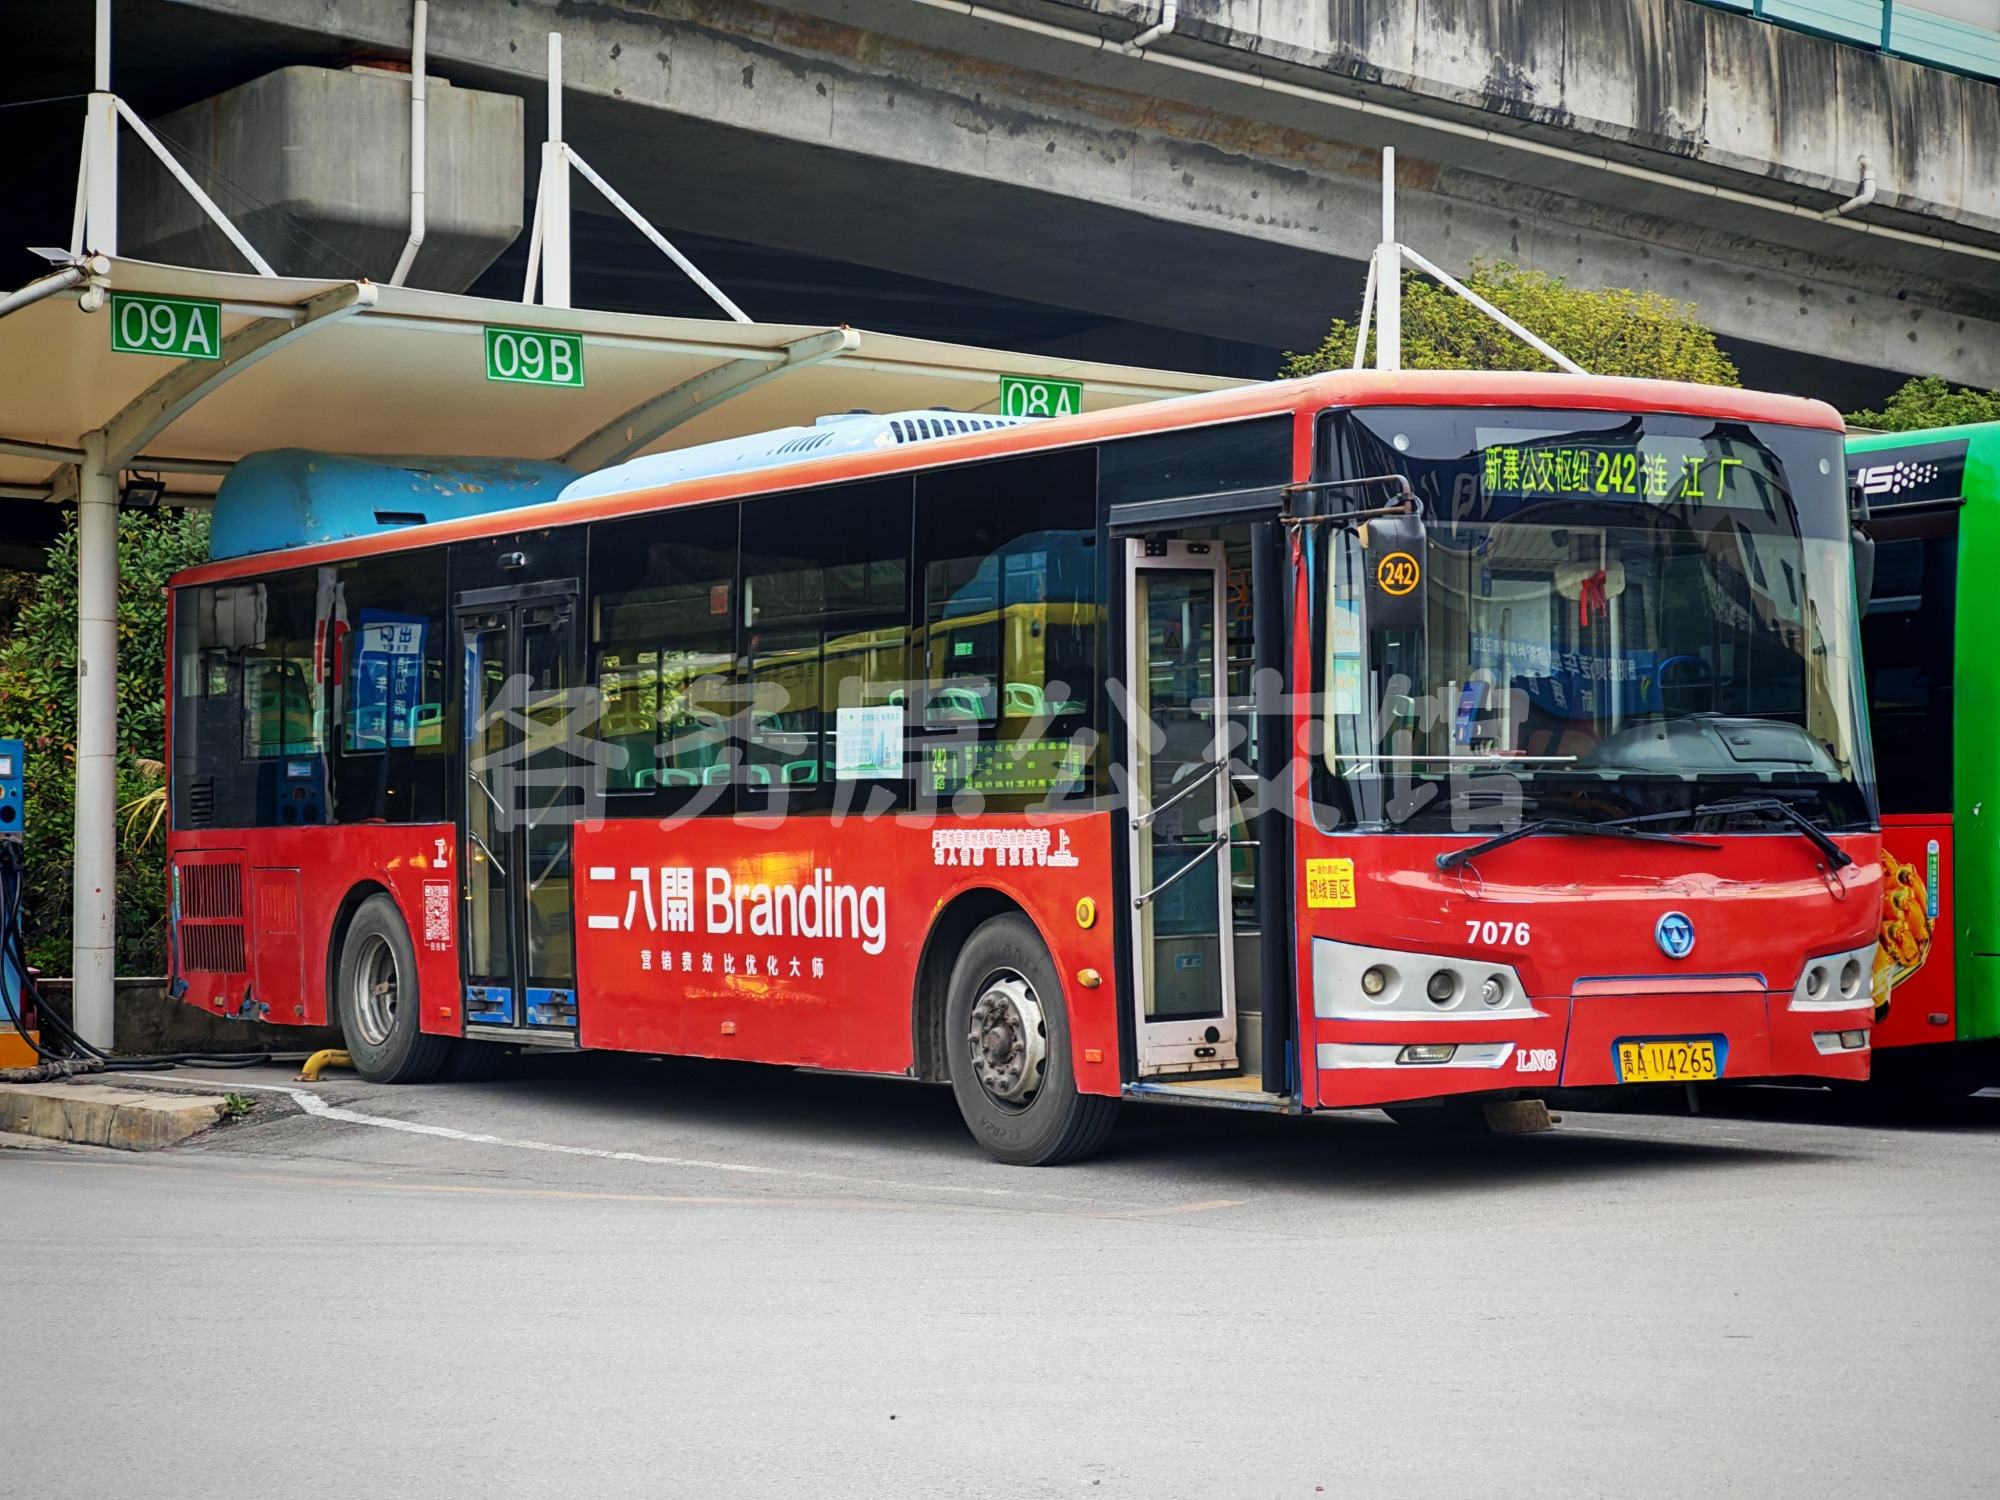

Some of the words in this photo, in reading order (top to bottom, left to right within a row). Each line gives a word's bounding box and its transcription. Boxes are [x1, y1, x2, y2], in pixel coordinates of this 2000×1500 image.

[121, 302, 212, 354] 09A
[494, 334, 574, 382] 09B
[1007, 382, 1072, 417] 08A
[1485, 447, 1590, 492] 新寨公交枢纽
[1596, 453, 1636, 494] 242
[1385, 562, 1413, 585] 242
[1054, 828, 1070, 857] 上
[1310, 879, 1351, 899] 视线盲区
[588, 866, 695, 933] 二八開
[706, 867, 886, 955] Branding
[1466, 920, 1531, 946] 7076
[641, 950, 824, 979] 营销费效比优化大师
[1516, 1049, 1557, 1072] LNG
